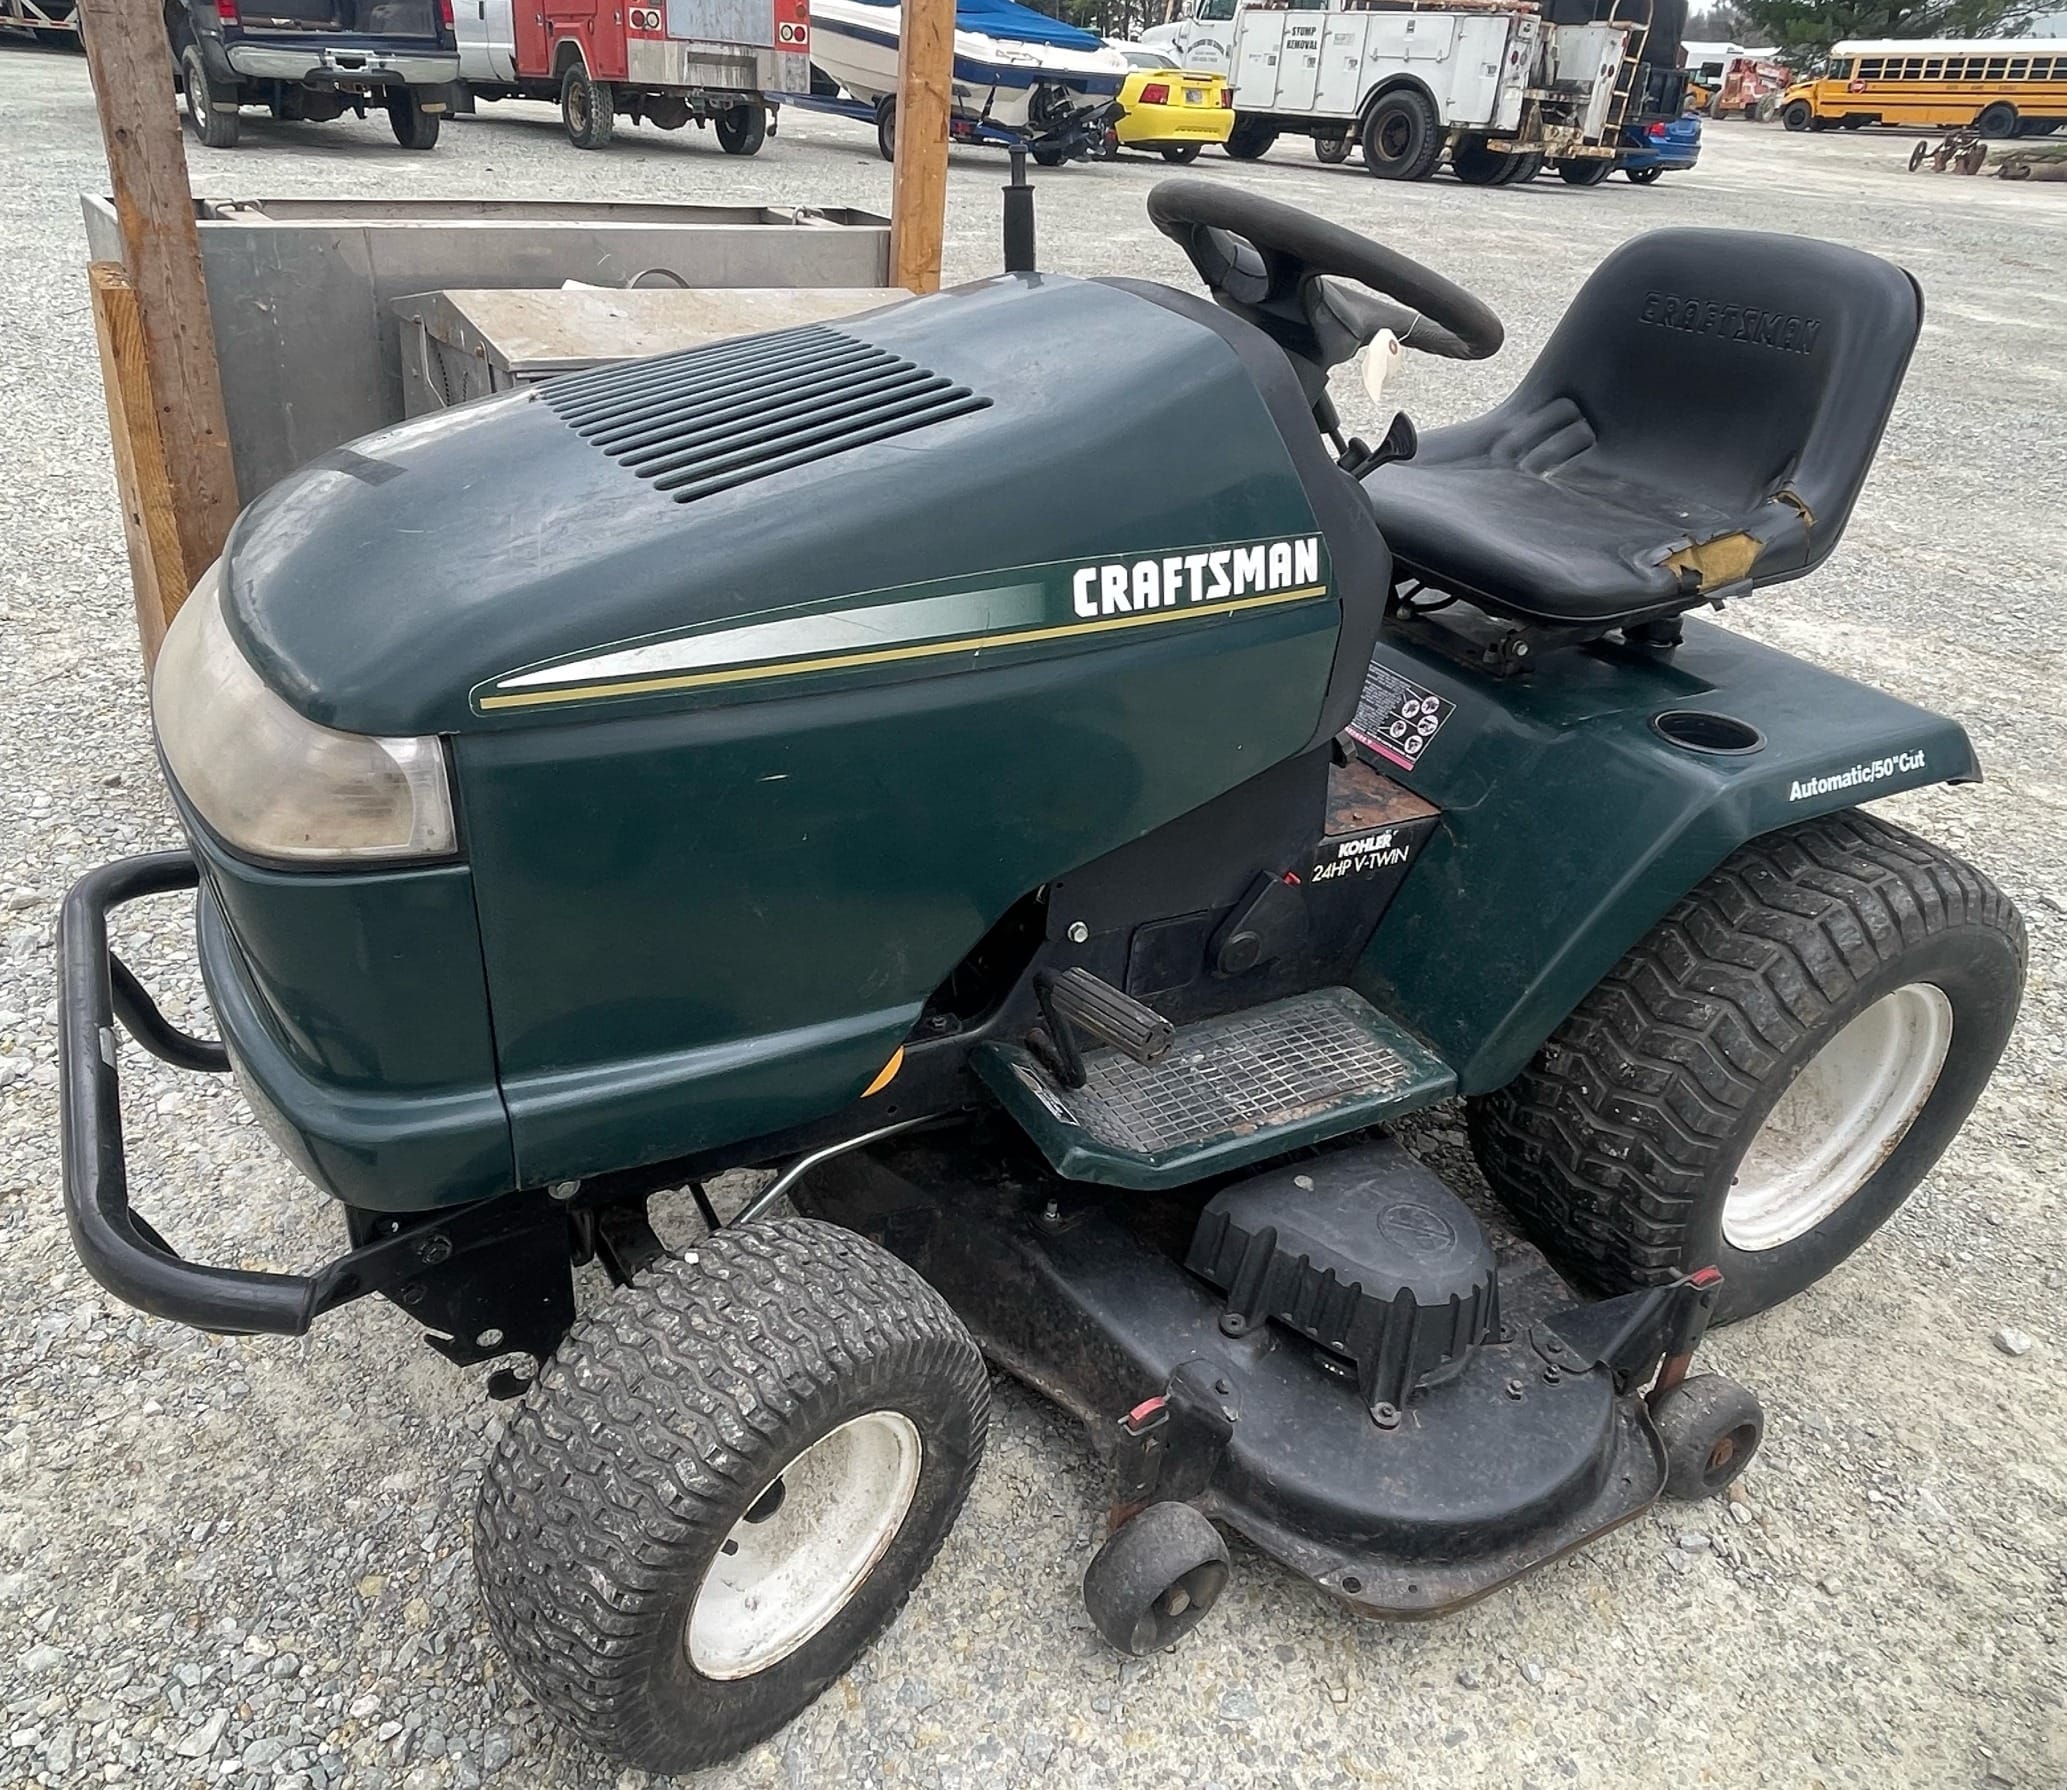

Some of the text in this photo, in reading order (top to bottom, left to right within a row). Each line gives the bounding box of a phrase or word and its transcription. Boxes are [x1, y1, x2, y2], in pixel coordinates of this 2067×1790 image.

[1286, 39, 1318, 50] REMOVAL
[1292, 26, 1317, 37] STUMP
[1639, 290, 1821, 355] CRAFTSMAN
[1073, 537, 1318, 618] CRAFTSMAN
[1338, 832, 1394, 858] KOHLER
[1311, 845, 1409, 882] 24HP V-TWIN
